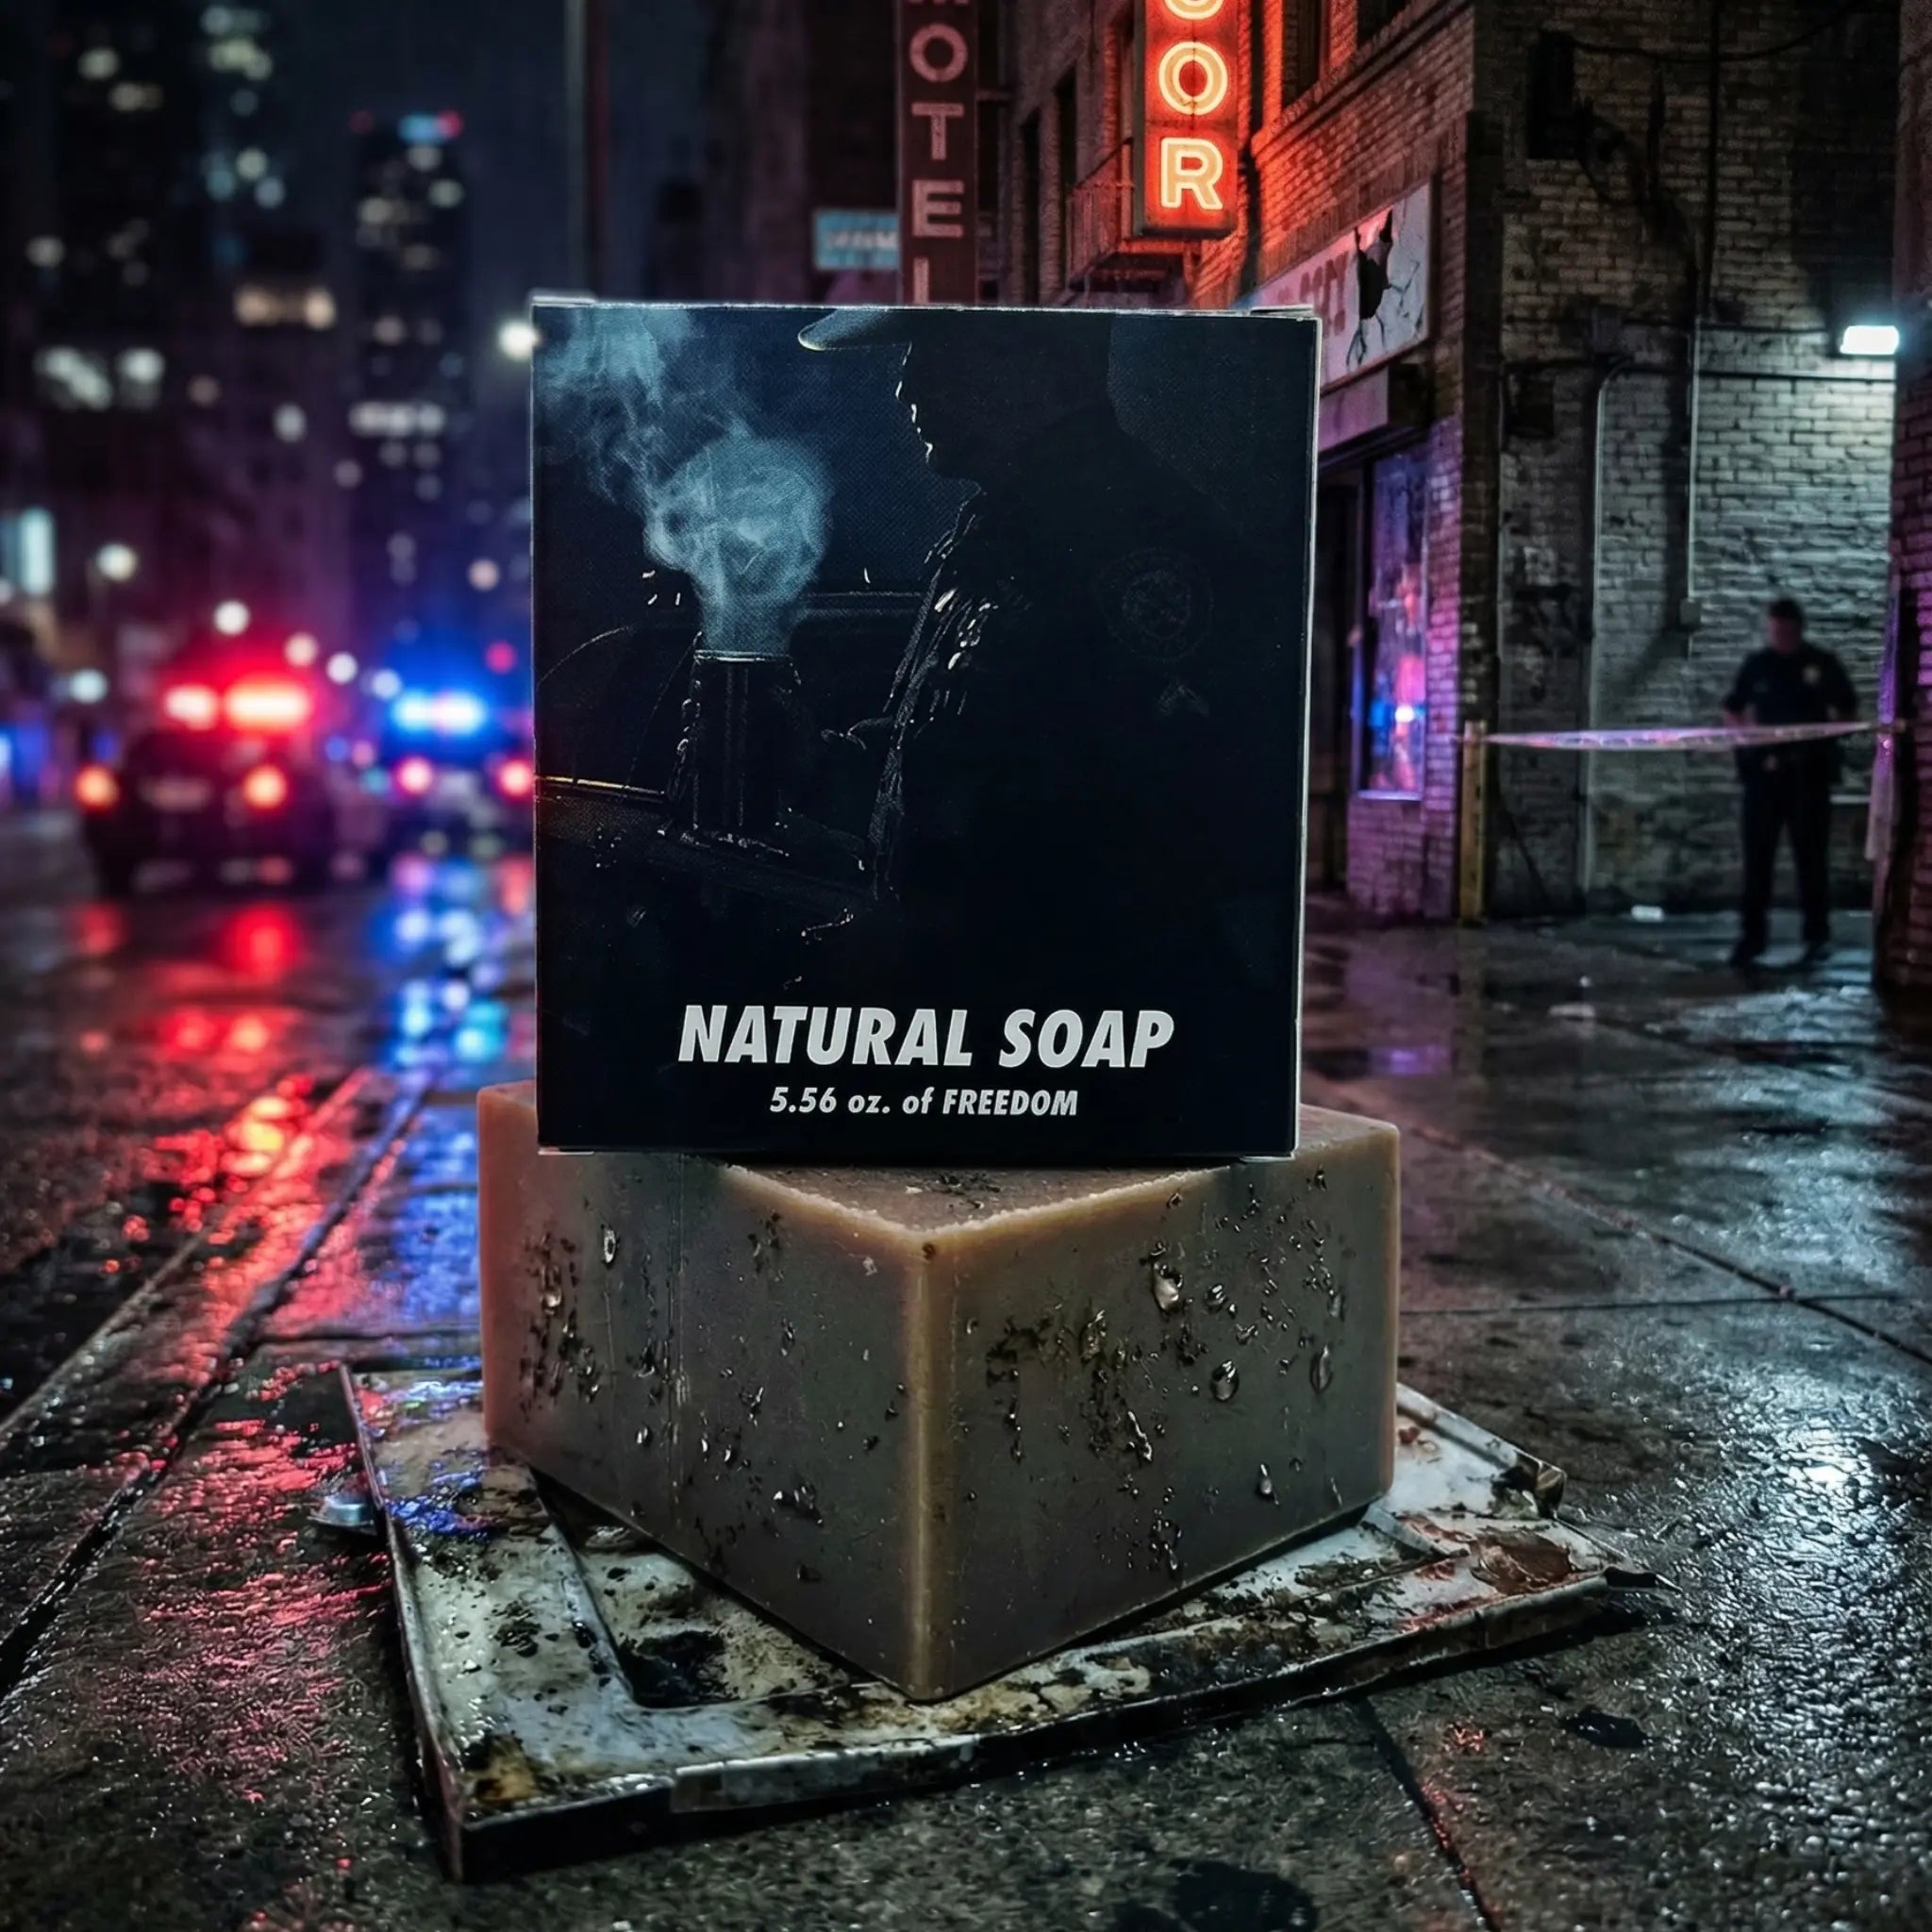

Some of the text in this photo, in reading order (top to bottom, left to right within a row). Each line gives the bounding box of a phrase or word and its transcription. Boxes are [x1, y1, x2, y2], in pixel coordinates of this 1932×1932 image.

[908, 0, 969, 304] OTE
[1158, 0, 1228, 210] OR
[677, 1004, 1175, 1069] NATURAL SOAP
[769, 1086, 1078, 1117] 5.56 oz. of FREEDOM
